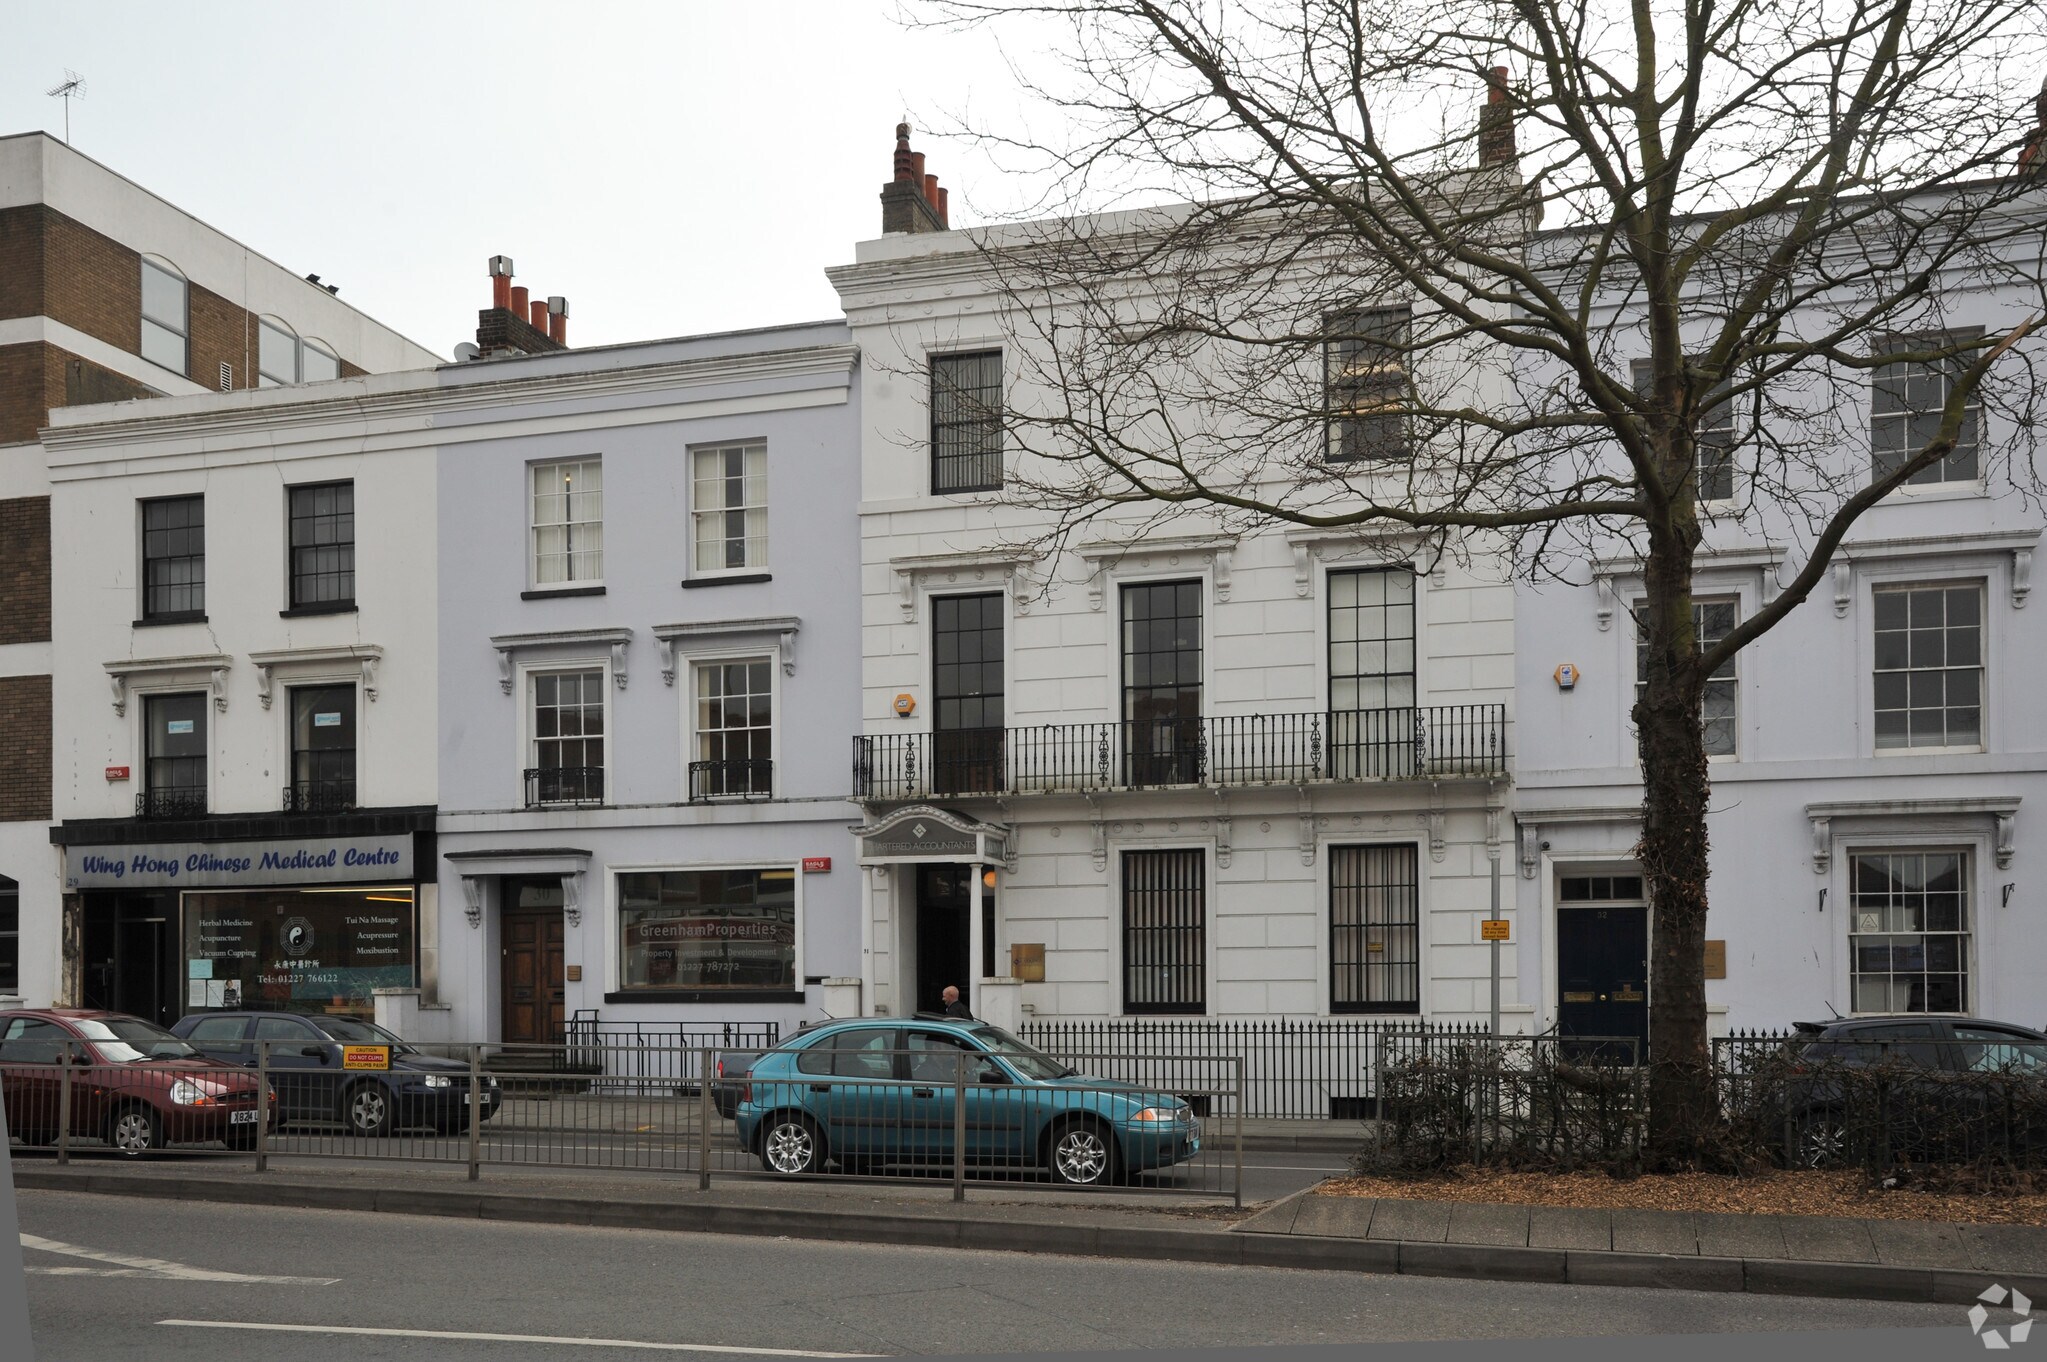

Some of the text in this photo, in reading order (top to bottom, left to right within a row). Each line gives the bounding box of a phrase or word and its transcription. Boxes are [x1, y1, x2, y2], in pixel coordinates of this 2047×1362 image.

[913, 840, 976, 851] ACCOUNTANTS
[83, 847, 399, 878] Wing Hong Chinese Medical Centre
[67, 878, 79, 887] 29
[533, 888, 550, 901] 30
[199, 919, 254, 927] Herbal Medicine
[359, 916, 370, 924] Na
[370, 916, 399, 925] Massage
[199, 934, 242, 943] Acupuncture
[357, 931, 399, 940] Acupressure
[199, 949, 257, 958] Vacuum Cupping
[356, 947, 399, 955] Moxibustion
[641, 947, 777, 960] Property Investment & Development
[677, 961, 704, 973] 01227
[707, 960, 740, 973] 787272
[278, 974, 304, 983] 01227
[308, 974, 338, 983] 766122
